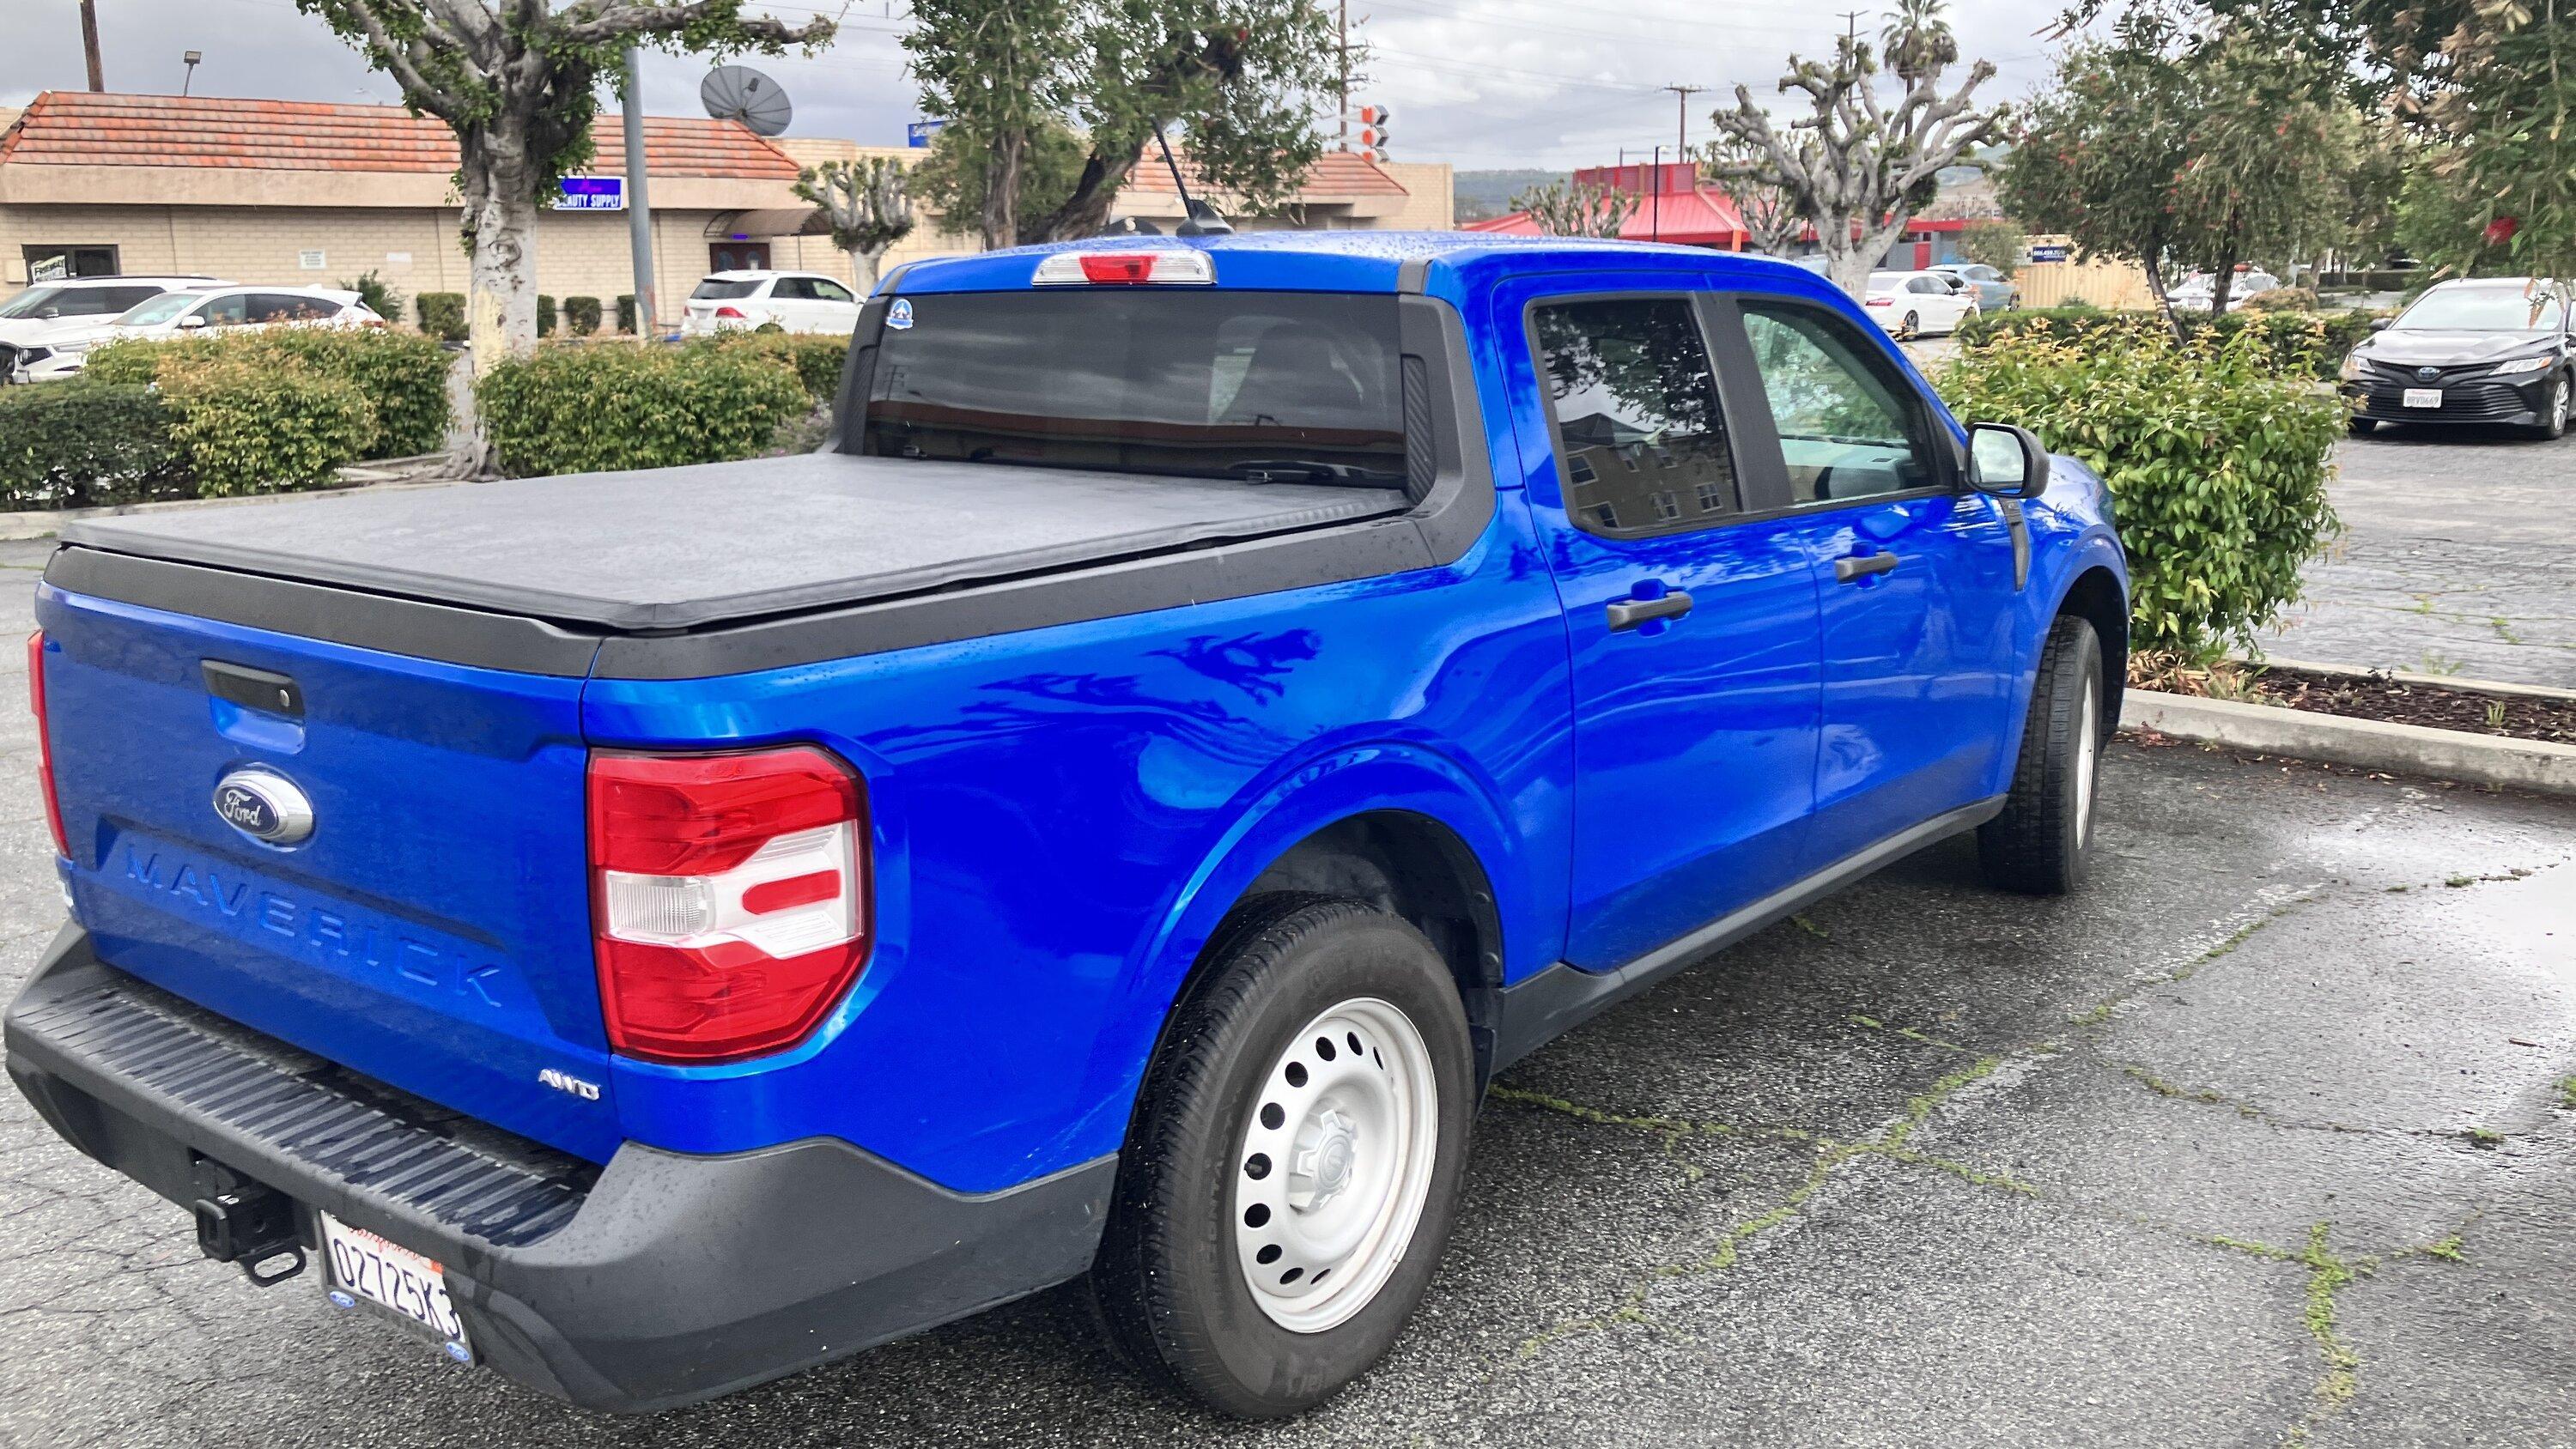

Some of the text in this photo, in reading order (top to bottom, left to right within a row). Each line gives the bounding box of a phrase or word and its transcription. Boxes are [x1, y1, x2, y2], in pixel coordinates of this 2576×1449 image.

[557, 195, 620, 207] AUTY SUPPLY
[223, 789, 262, 827] Ford
[125, 845, 502, 1008] MAVERICK
[538, 1069, 599, 1100] AWD
[333, 1238, 461, 1341] 02725K3
